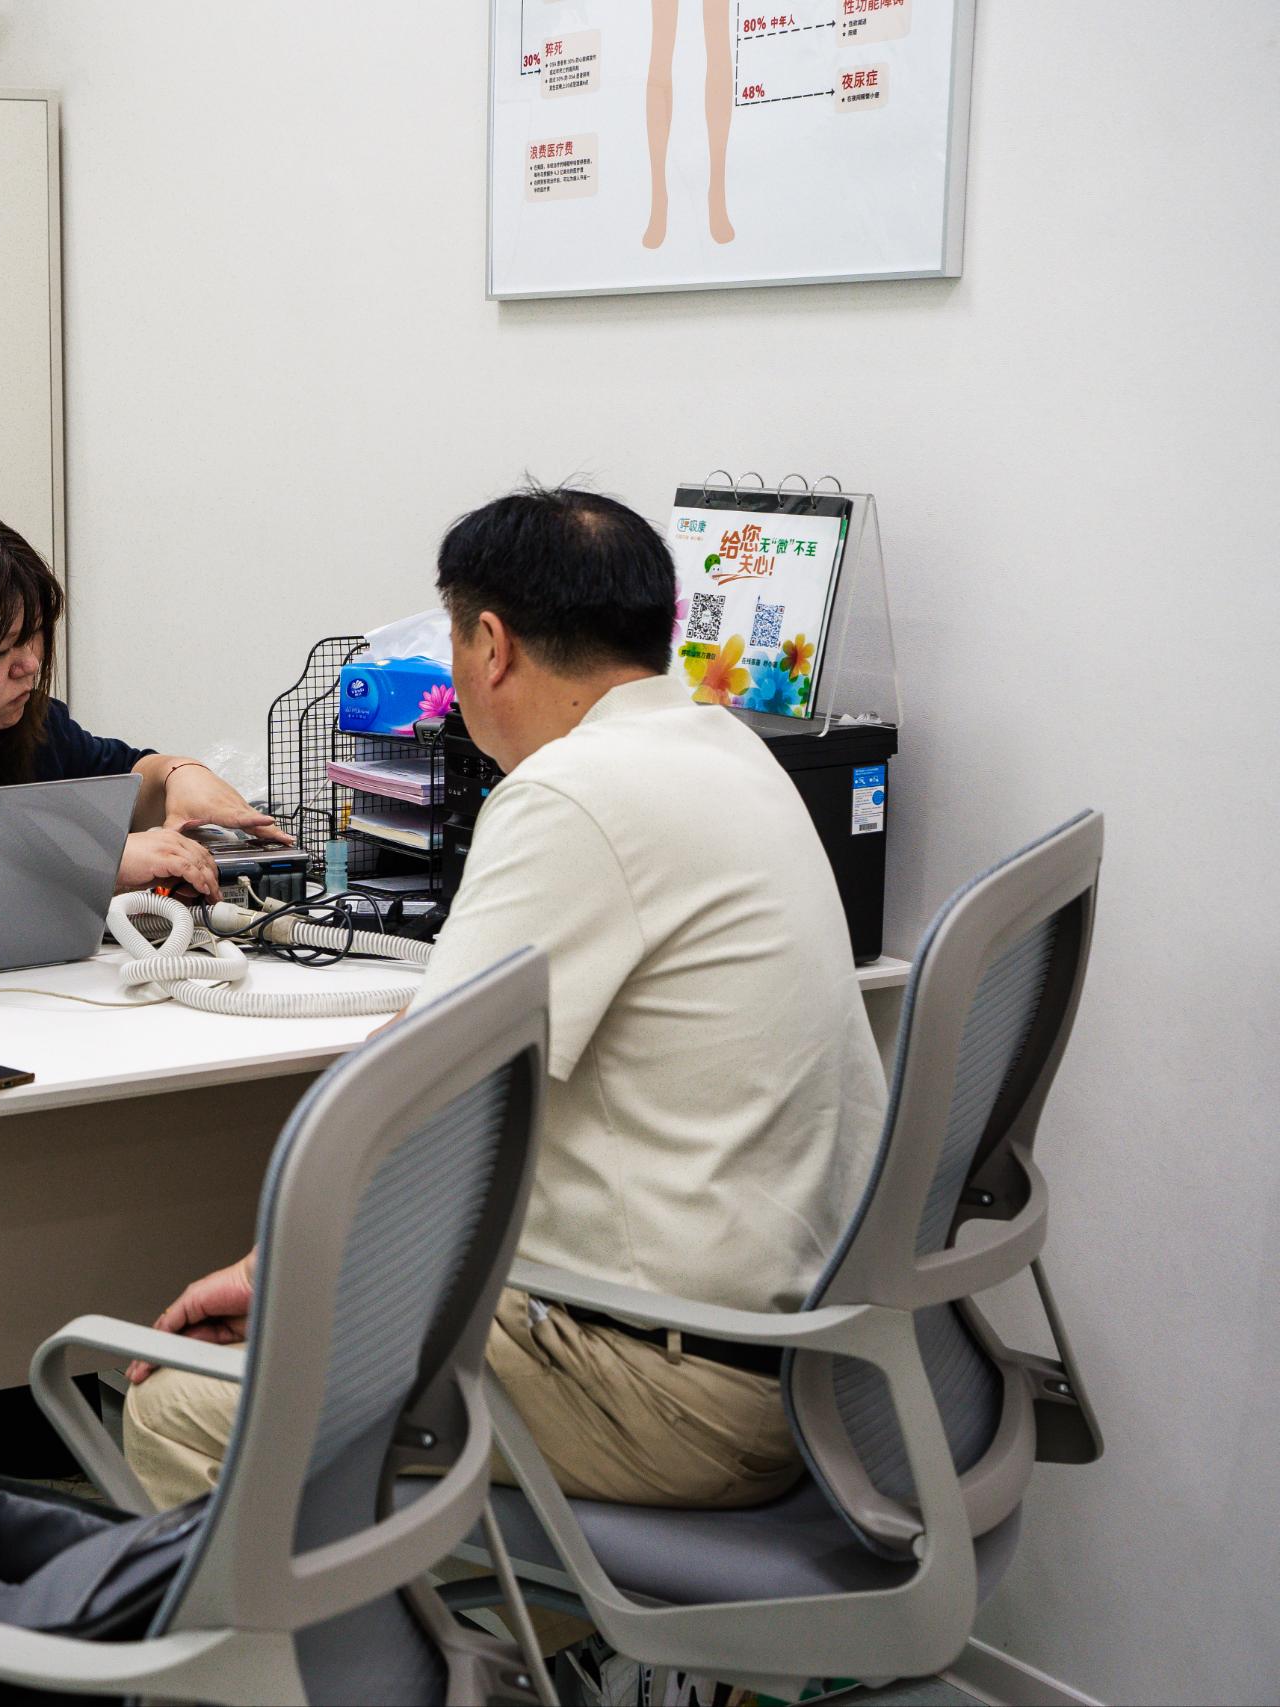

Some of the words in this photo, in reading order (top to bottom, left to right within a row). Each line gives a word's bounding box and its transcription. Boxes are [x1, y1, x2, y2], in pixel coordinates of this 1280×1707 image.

[743, 16, 766, 33] 80%
[770, 14, 795, 29] 中年人
[545, 41, 563, 57] 猝死
[523, 52, 541, 67] 30%
[841, 69, 878, 90] 夜尿症
[742, 84, 765, 100] 48%
[529, 141, 573, 159] 浪费医疗费
